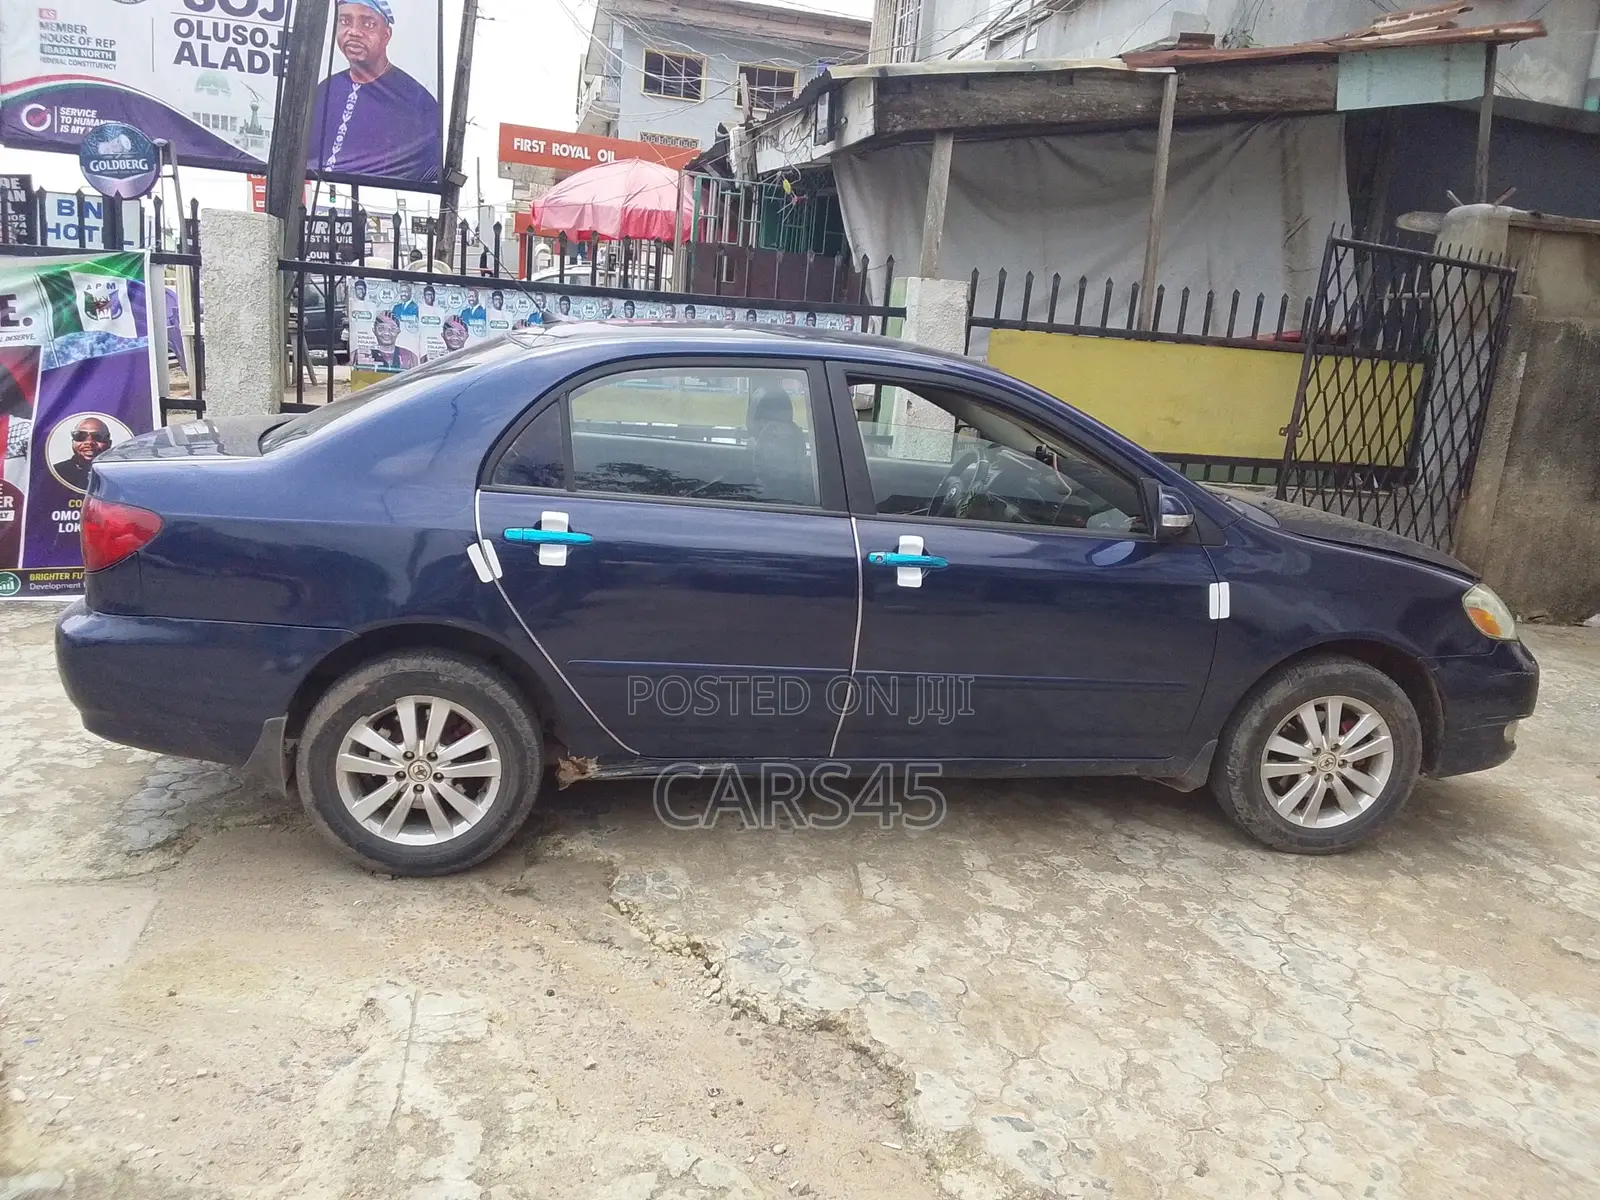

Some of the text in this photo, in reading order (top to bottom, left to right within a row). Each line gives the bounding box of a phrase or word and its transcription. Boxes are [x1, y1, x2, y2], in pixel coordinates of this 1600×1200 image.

[39, 22, 88, 35] MEMBER
[173, 18, 285, 50] OLUSOJ
[40, 33, 116, 48] HOUSE OF REP
[44, 45, 113, 60] IBADAN NORTH
[40, 57, 117, 70] FEDERAL CONSTITUENCY
[60, 107, 97, 118] SERVICE
[61, 116, 72, 124] TO
[60, 125, 70, 133] IS
[71, 126, 86, 134] MY
[513, 138, 616, 163] FIRST ROYAL OIL
[89, 159, 149, 172] GOLDBERG
[29, 573, 70, 581] BRIGHTER
[29, 583, 81, 591] Development
